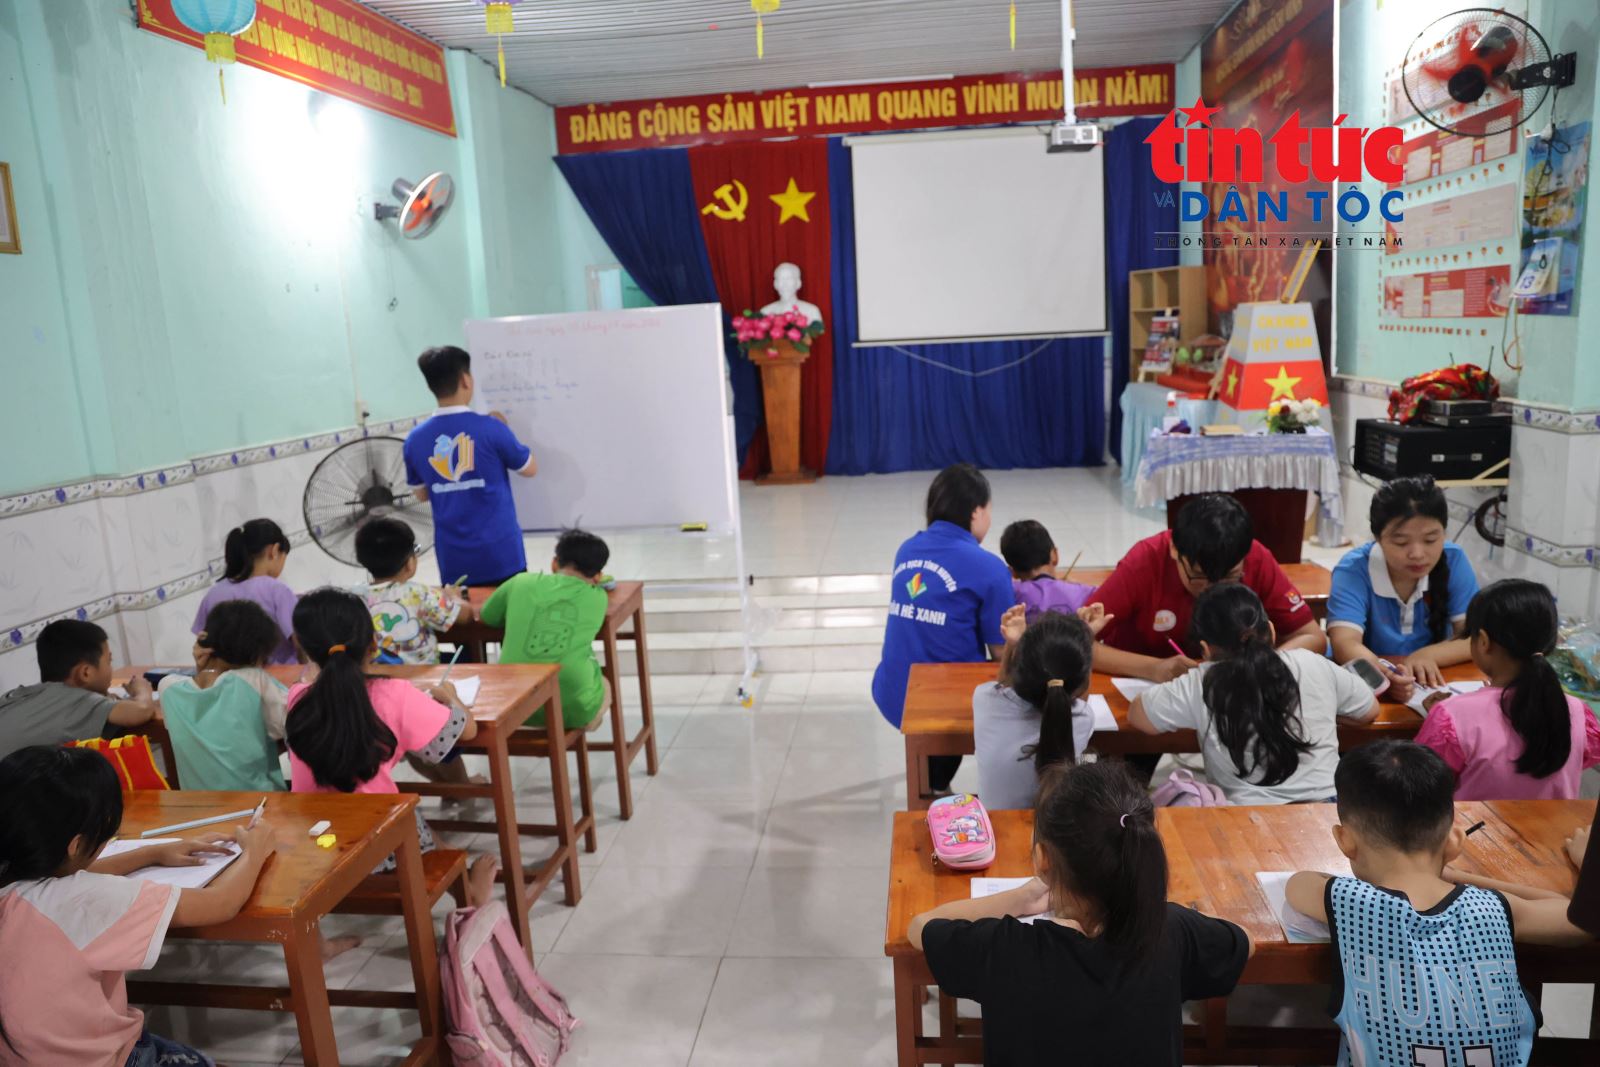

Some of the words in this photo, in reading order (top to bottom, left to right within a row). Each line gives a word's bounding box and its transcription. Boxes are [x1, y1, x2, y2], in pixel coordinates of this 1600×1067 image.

[570, 104, 632, 143] ĐẢNG
[638, 102, 701, 142] CỘNG
[707, 94, 755, 132] SẢN
[760, 91, 808, 132] VIỆT
[816, 93, 871, 125] NAM
[878, 86, 957, 122] QUANG
[1026, 78, 1098, 111] MUN
[916, 607, 946, 626] XANH
